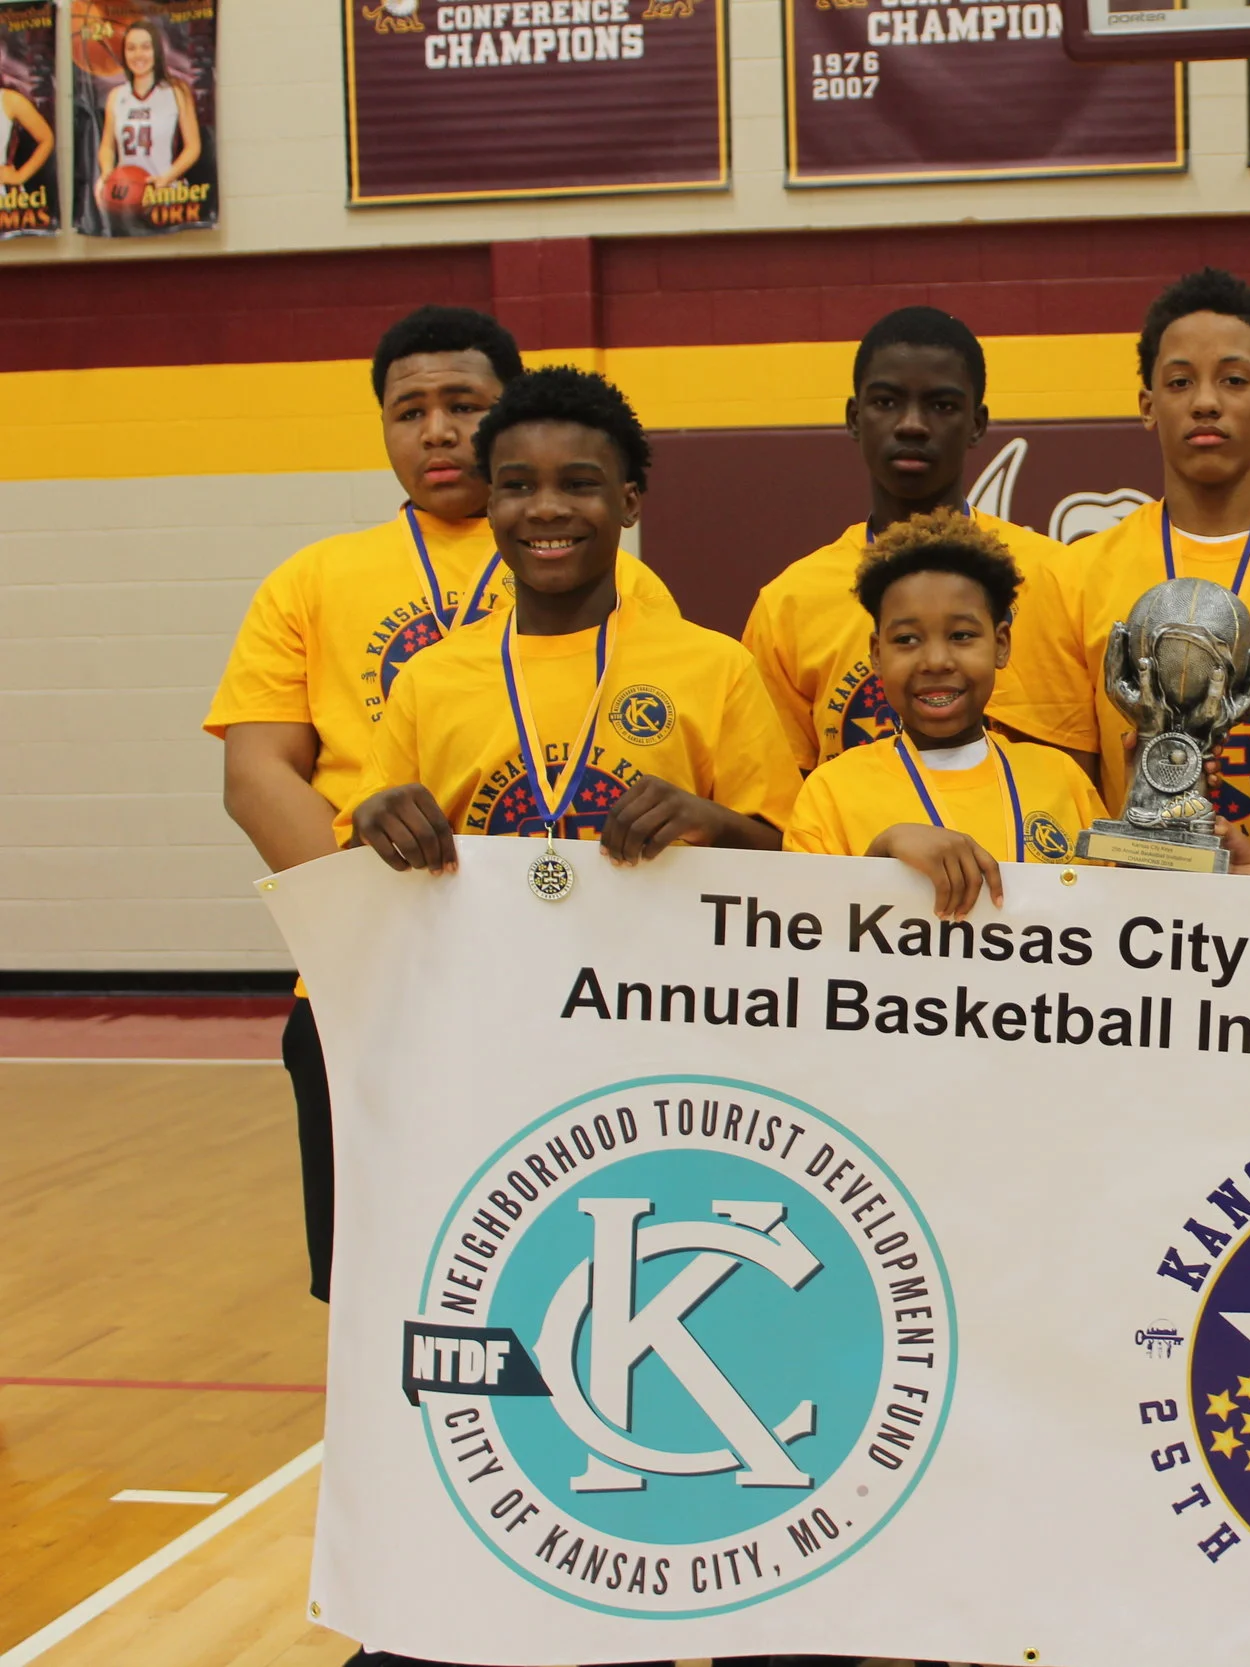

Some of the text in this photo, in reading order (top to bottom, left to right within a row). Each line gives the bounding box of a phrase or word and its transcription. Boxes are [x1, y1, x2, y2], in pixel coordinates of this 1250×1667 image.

[437, 0, 630, 31] CONFERENCE
[425, 24, 645, 69] CHAMPIONS
[812, 51, 880, 76] 1976
[812, 76, 880, 100] 2007
[122, 124, 153, 156] 24
[142, 183, 210, 207] Amber
[828, 654, 872, 713] KANS
[545, 742, 606, 766] CIY
[700, 893, 823, 950] The
[849, 902, 1093, 967] Kansas
[1119, 915, 1249, 988] City
[560, 966, 798, 1028] Annual
[825, 978, 1172, 1049] Basketball
[441, 1098, 935, 1472] NEIGHBORHOOD TOURIST DEVELOPMENT FUND
[411, 1333, 511, 1386] NTDF
[444, 1407, 854, 1595] CITY OF KANSAS CITY, MO.
[1139, 1398, 1242, 1564] 25TH
